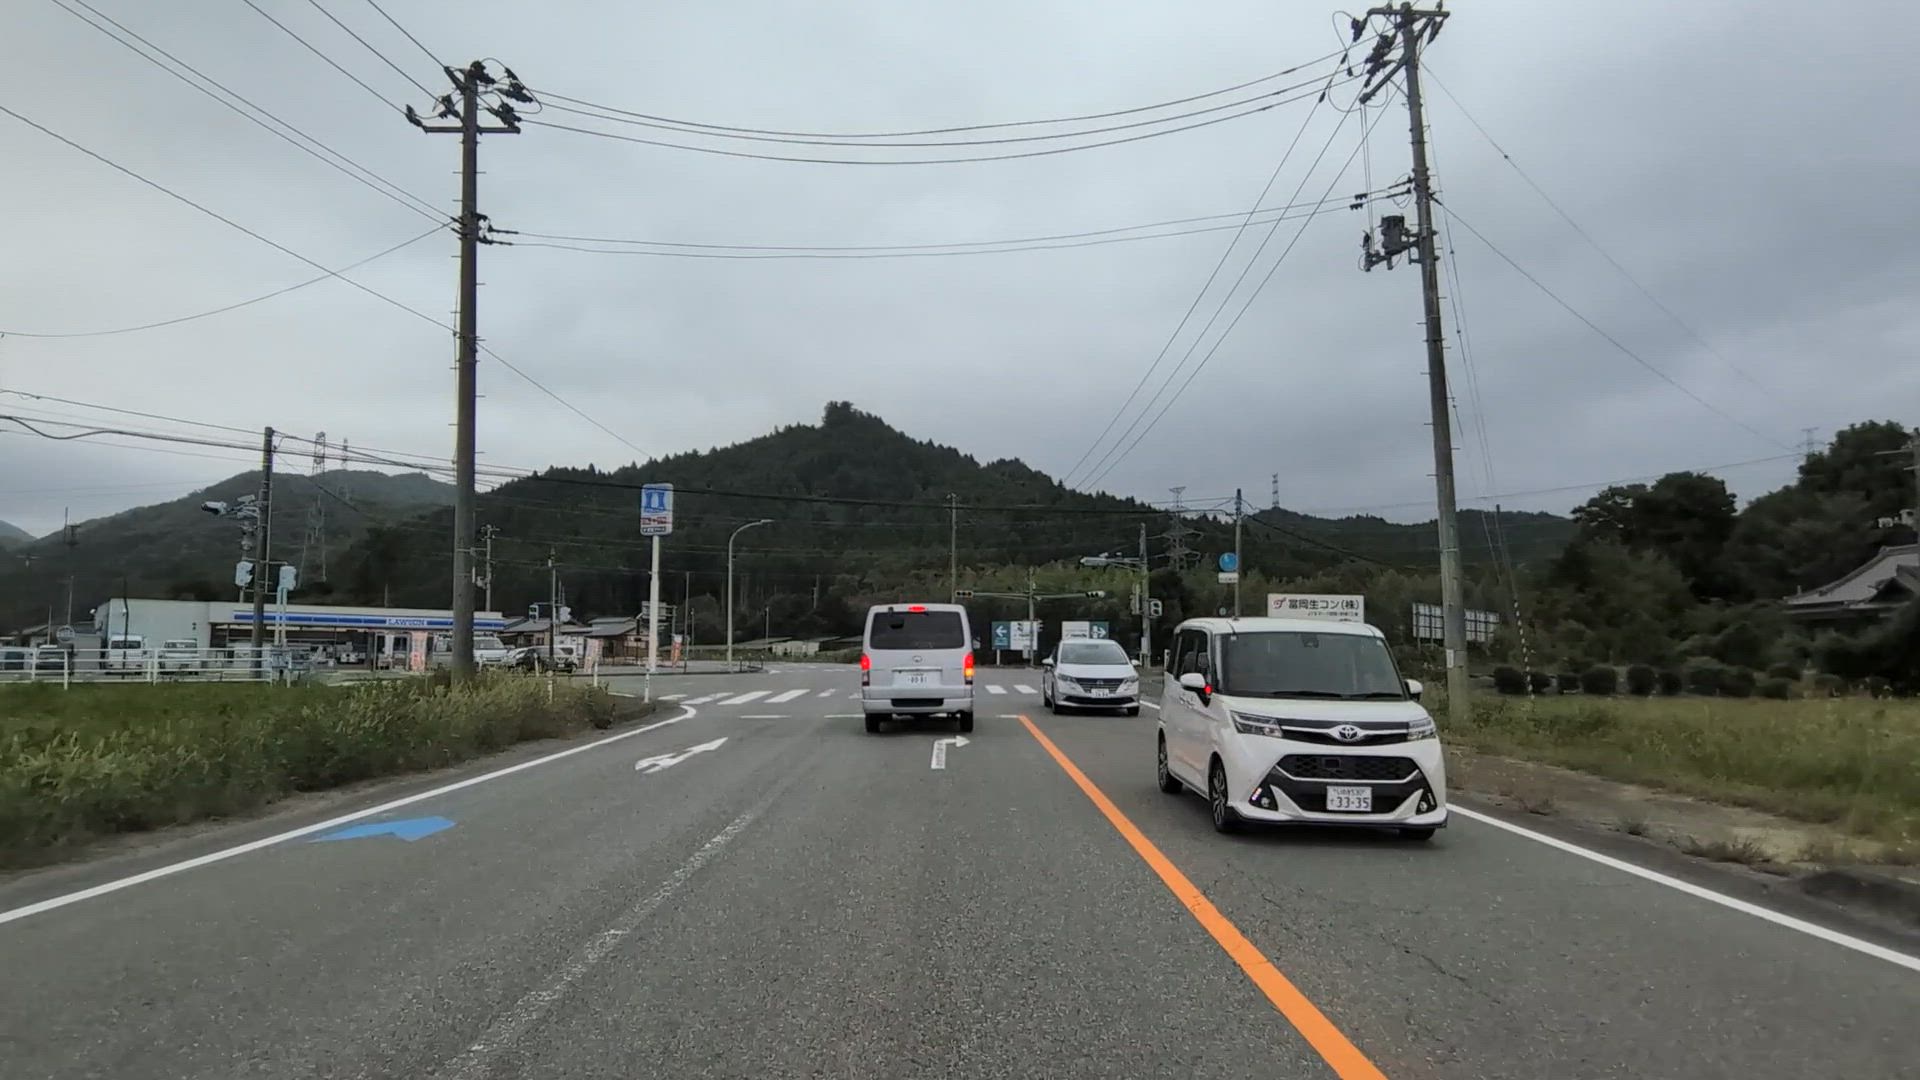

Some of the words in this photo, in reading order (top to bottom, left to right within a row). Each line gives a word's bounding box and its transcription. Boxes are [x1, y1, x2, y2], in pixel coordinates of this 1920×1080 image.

[1288, 599, 1360, 610] 富岡生コン(株)
[385, 617, 428, 626] LAWSON
[1336, 796, 1370, 809] 33-35
